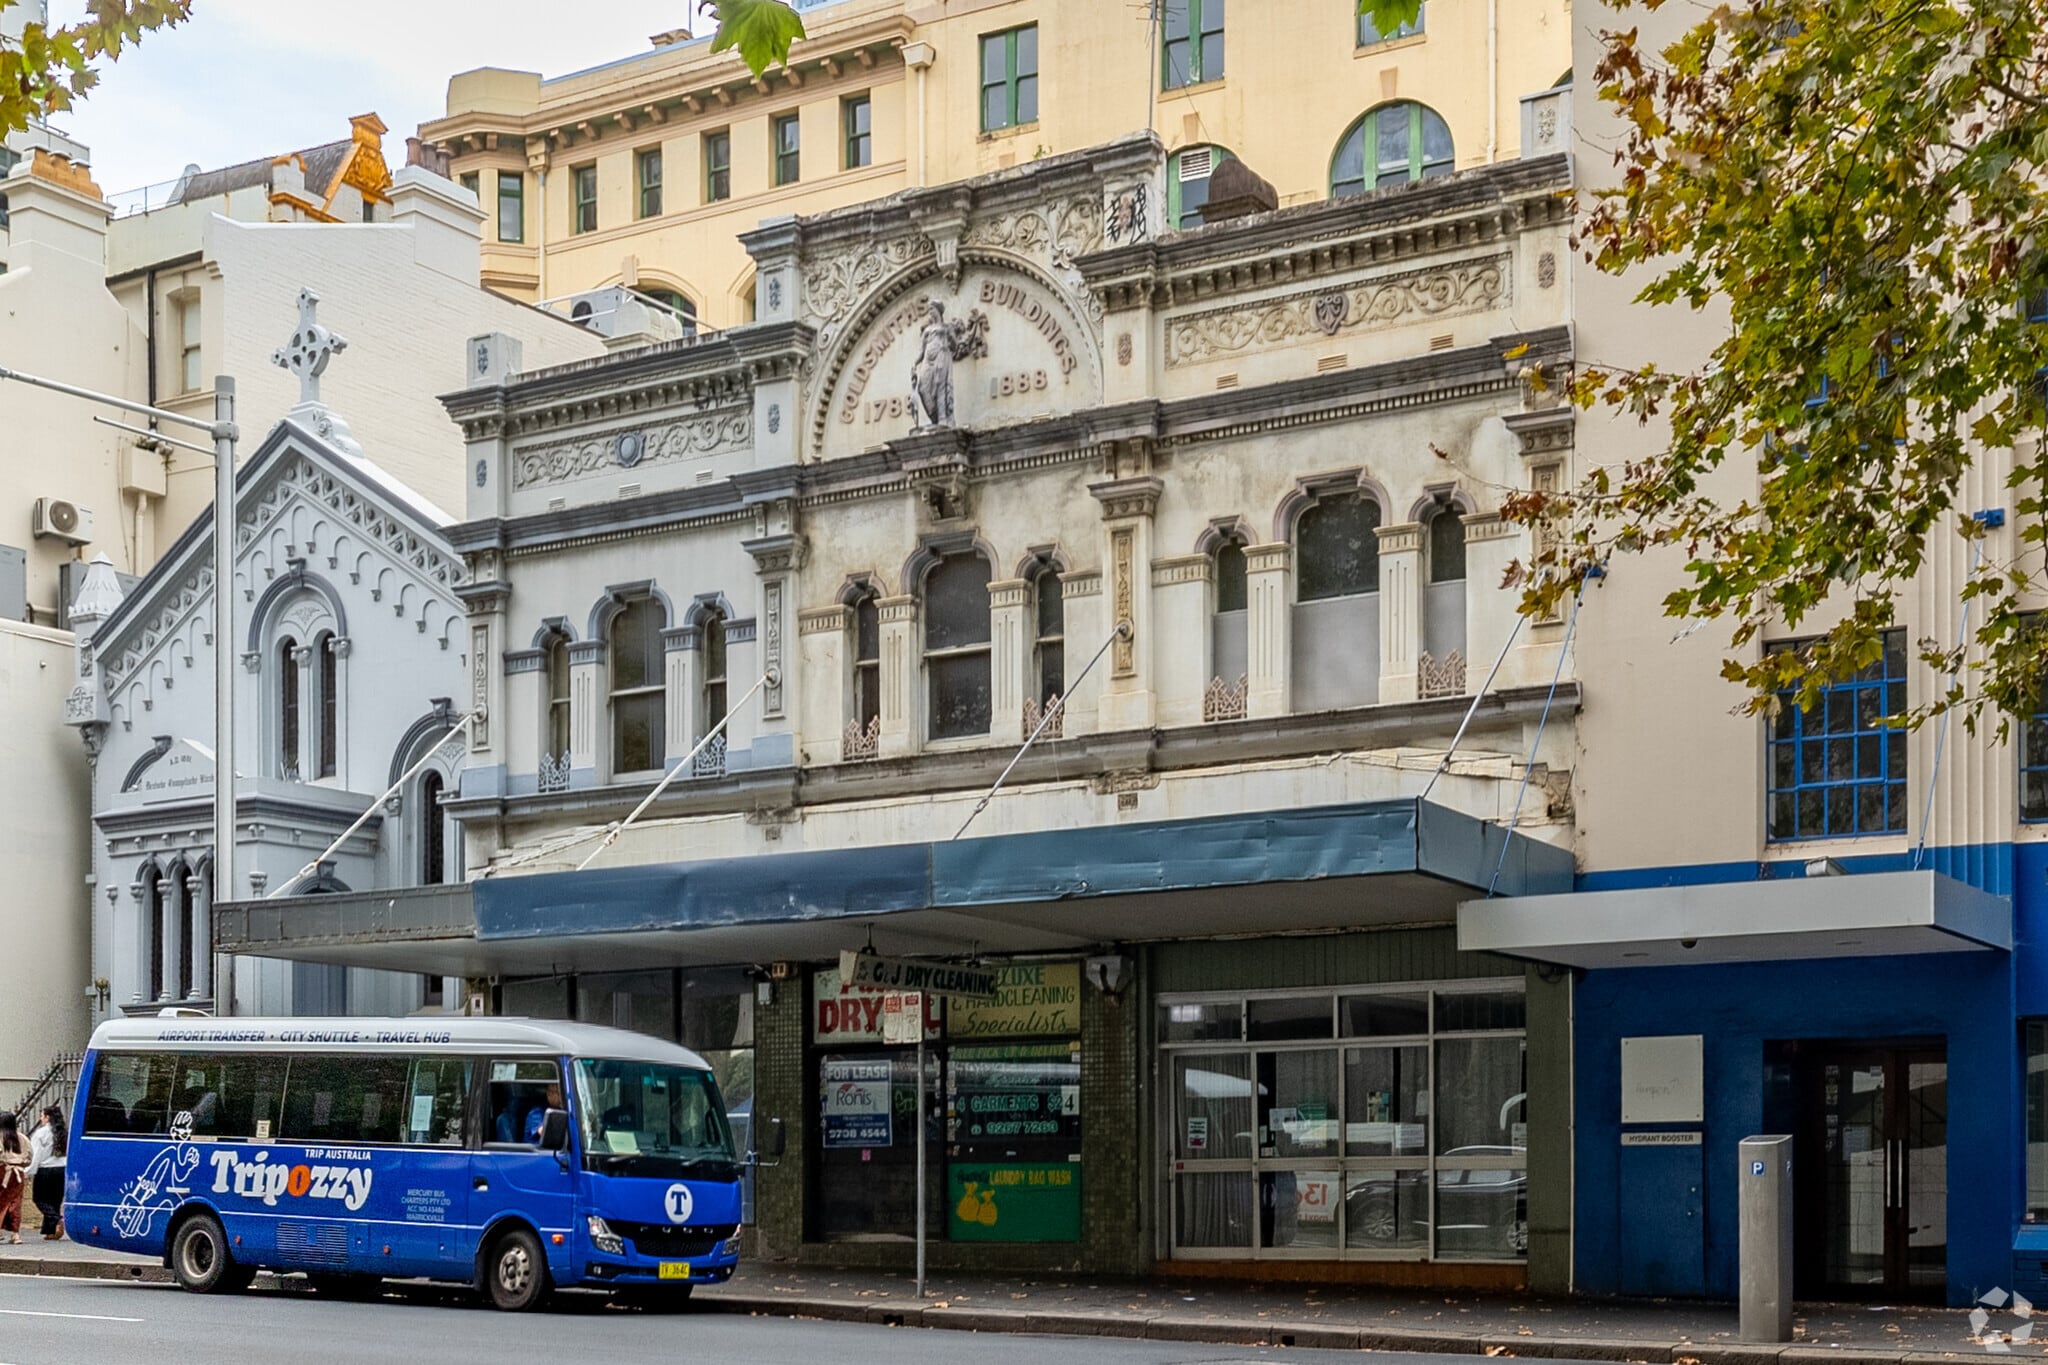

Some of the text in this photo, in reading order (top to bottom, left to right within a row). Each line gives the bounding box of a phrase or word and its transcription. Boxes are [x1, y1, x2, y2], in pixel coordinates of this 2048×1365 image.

[840, 295, 930, 424] GOLDSMITHS
[991, 369, 1047, 399] 1888
[962, 1007, 1068, 1035] Specialists
[158, 1030, 451, 1044] AIRPORT TRANSFER CITY SHUTTLE TRAVEL HUB
[828, 1065, 888, 1080] FOR LEASE
[971, 1094, 1040, 1113] GARMENTS
[860, 1127, 888, 1138] 4544
[1661, 1134, 1694, 1142] BOOSTER
[305, 1149, 372, 1161] TRIP AUSTRALIA
[1752, 1161, 1764, 1175] P
[210, 1150, 373, 1211] Tripozzy
[671, 1191, 687, 1215] T
